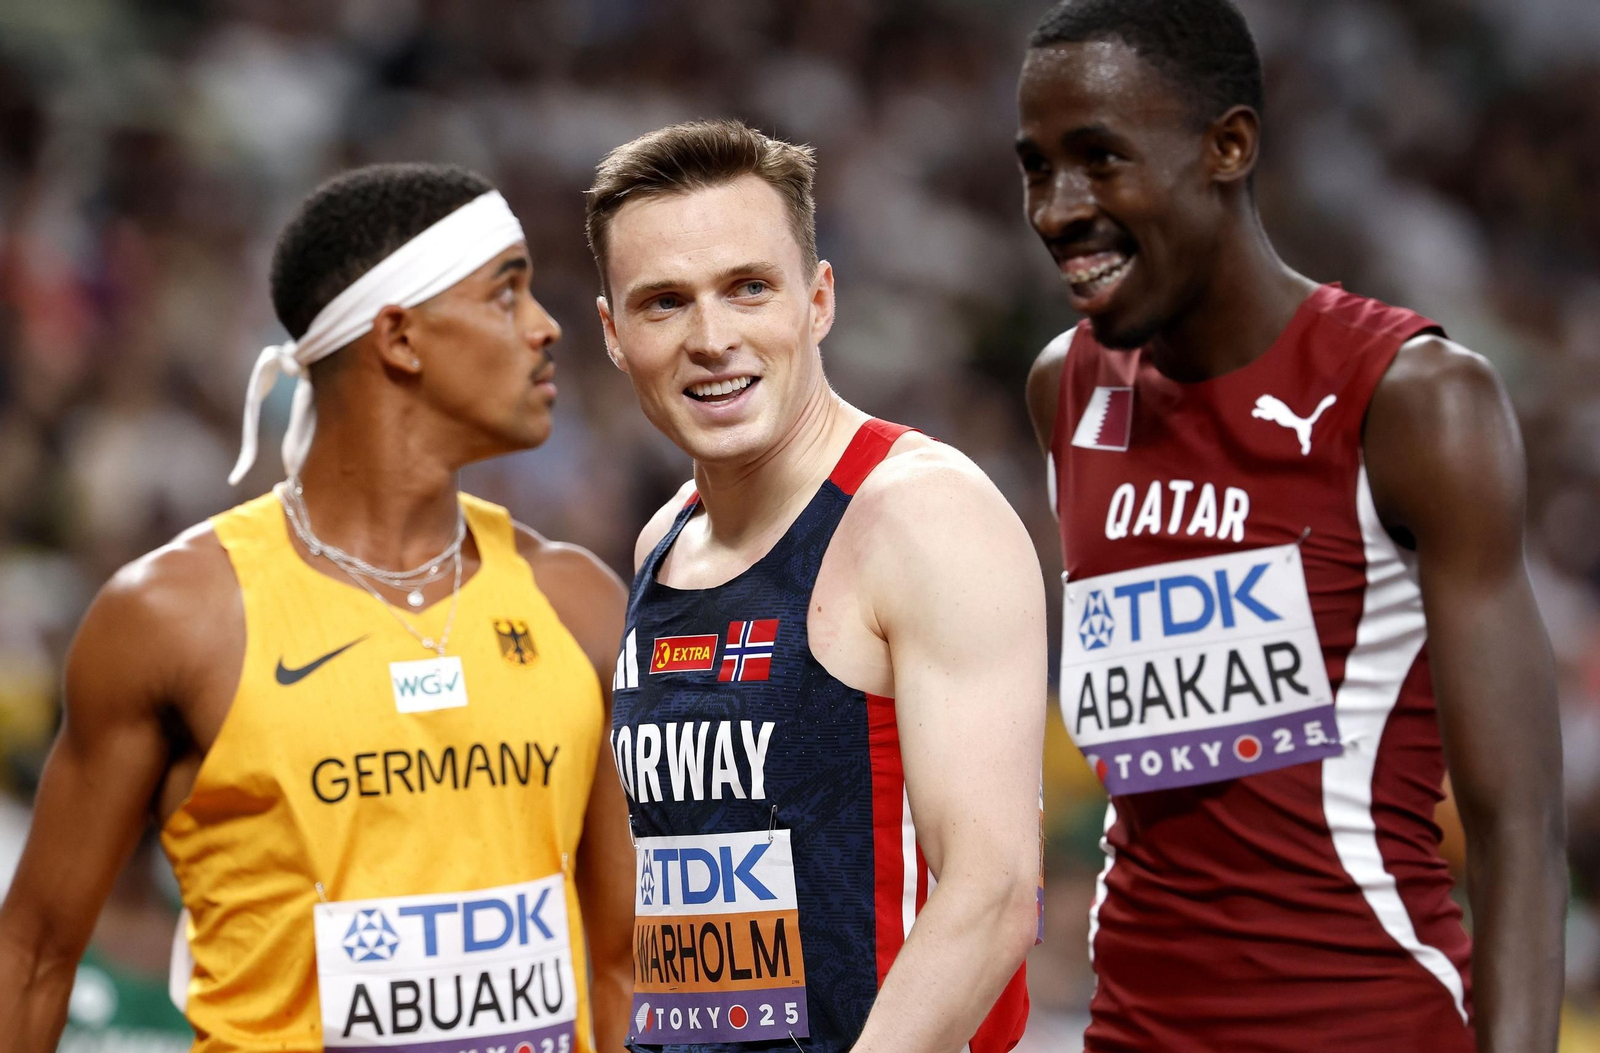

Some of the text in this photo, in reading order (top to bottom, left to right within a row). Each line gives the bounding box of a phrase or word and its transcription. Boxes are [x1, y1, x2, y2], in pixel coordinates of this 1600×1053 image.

[1105, 480, 1249, 543] QATAR
[1114, 562, 1285, 643] TDK
[672, 646, 710, 662] EXTRA
[1076, 641, 1310, 735] ABAKAR
[610, 720, 776, 804] ORWAY
[1271, 720, 1325, 754] 25
[311, 742, 560, 804] GERMANY
[653, 843, 779, 906] TDK
[398, 886, 555, 957] TDK
[636, 917, 792, 984] WARHOLM
[341, 958, 564, 1038] ABUAKU
[758, 1002, 800, 1026] 25
